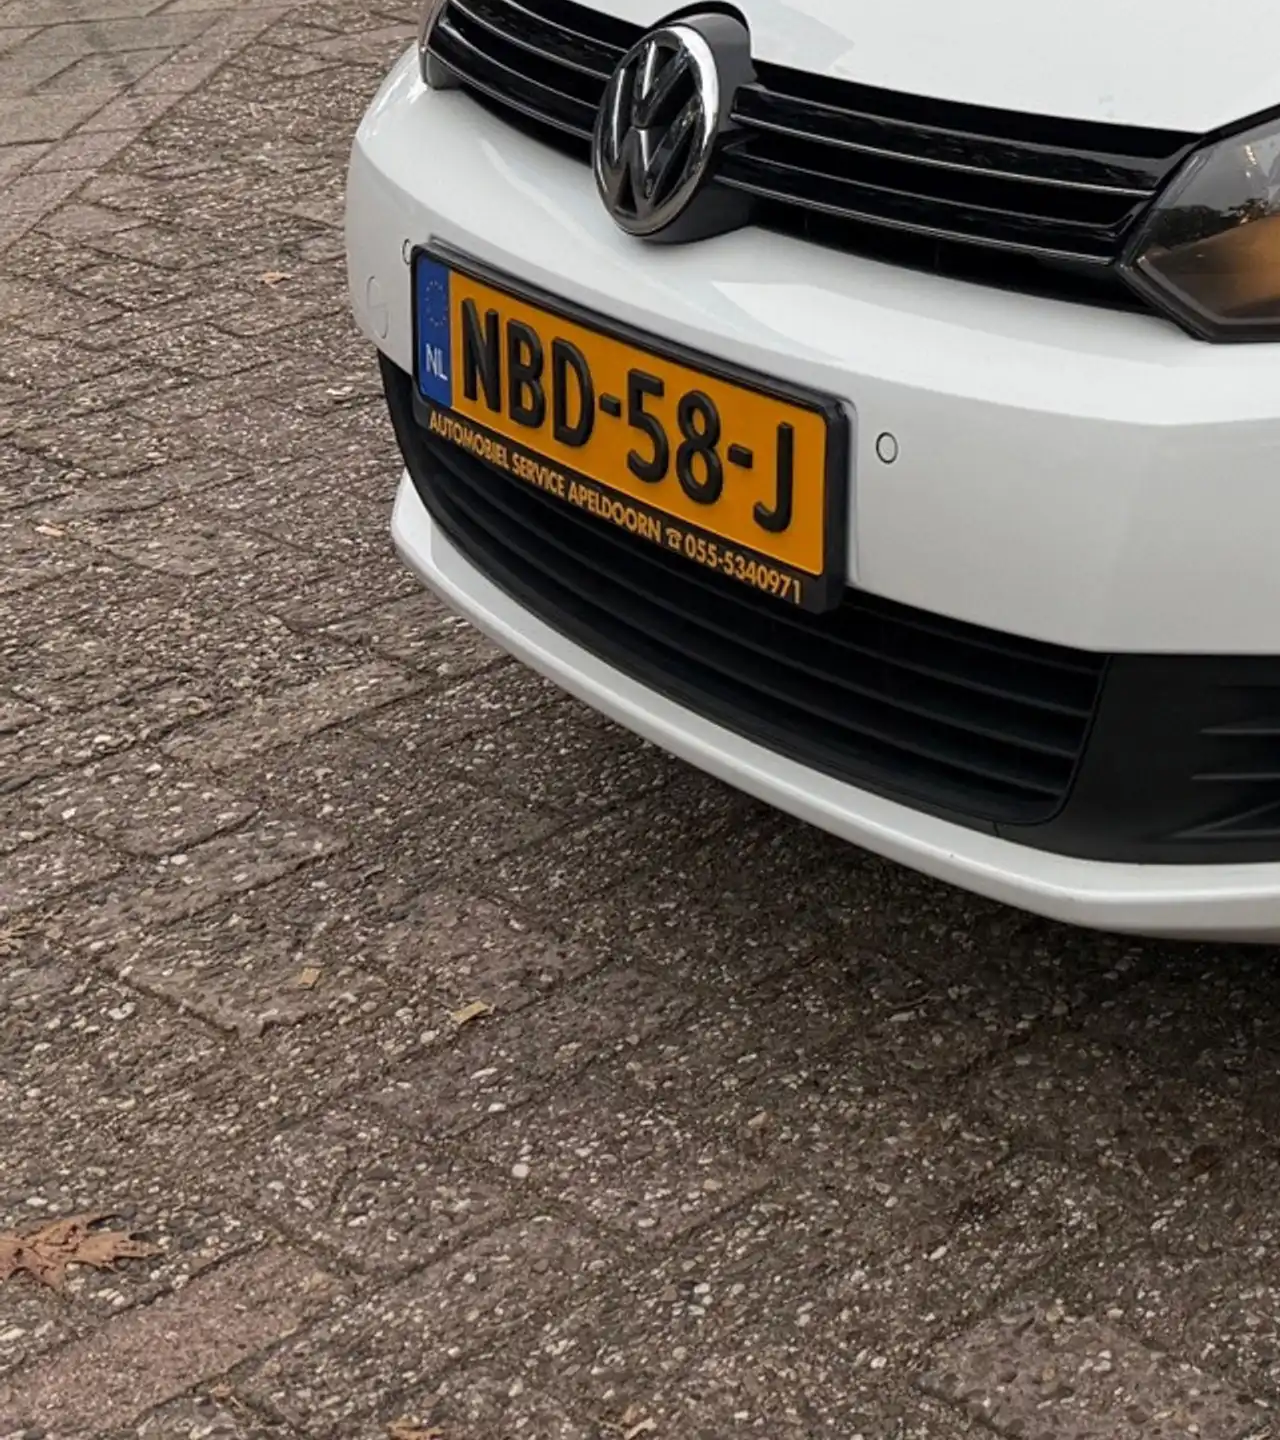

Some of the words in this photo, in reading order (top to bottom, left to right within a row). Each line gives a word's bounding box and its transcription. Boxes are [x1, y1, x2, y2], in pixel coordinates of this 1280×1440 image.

[424, 343, 448, 381] NL
[461, 297, 795, 534] NBD-58-J
[428, 410, 509, 470] AUTOMOBIEL
[512, 452, 565, 497] SERVICE
[568, 481, 662, 543] APELDOORN
[684, 536, 802, 605] 055-5340971
